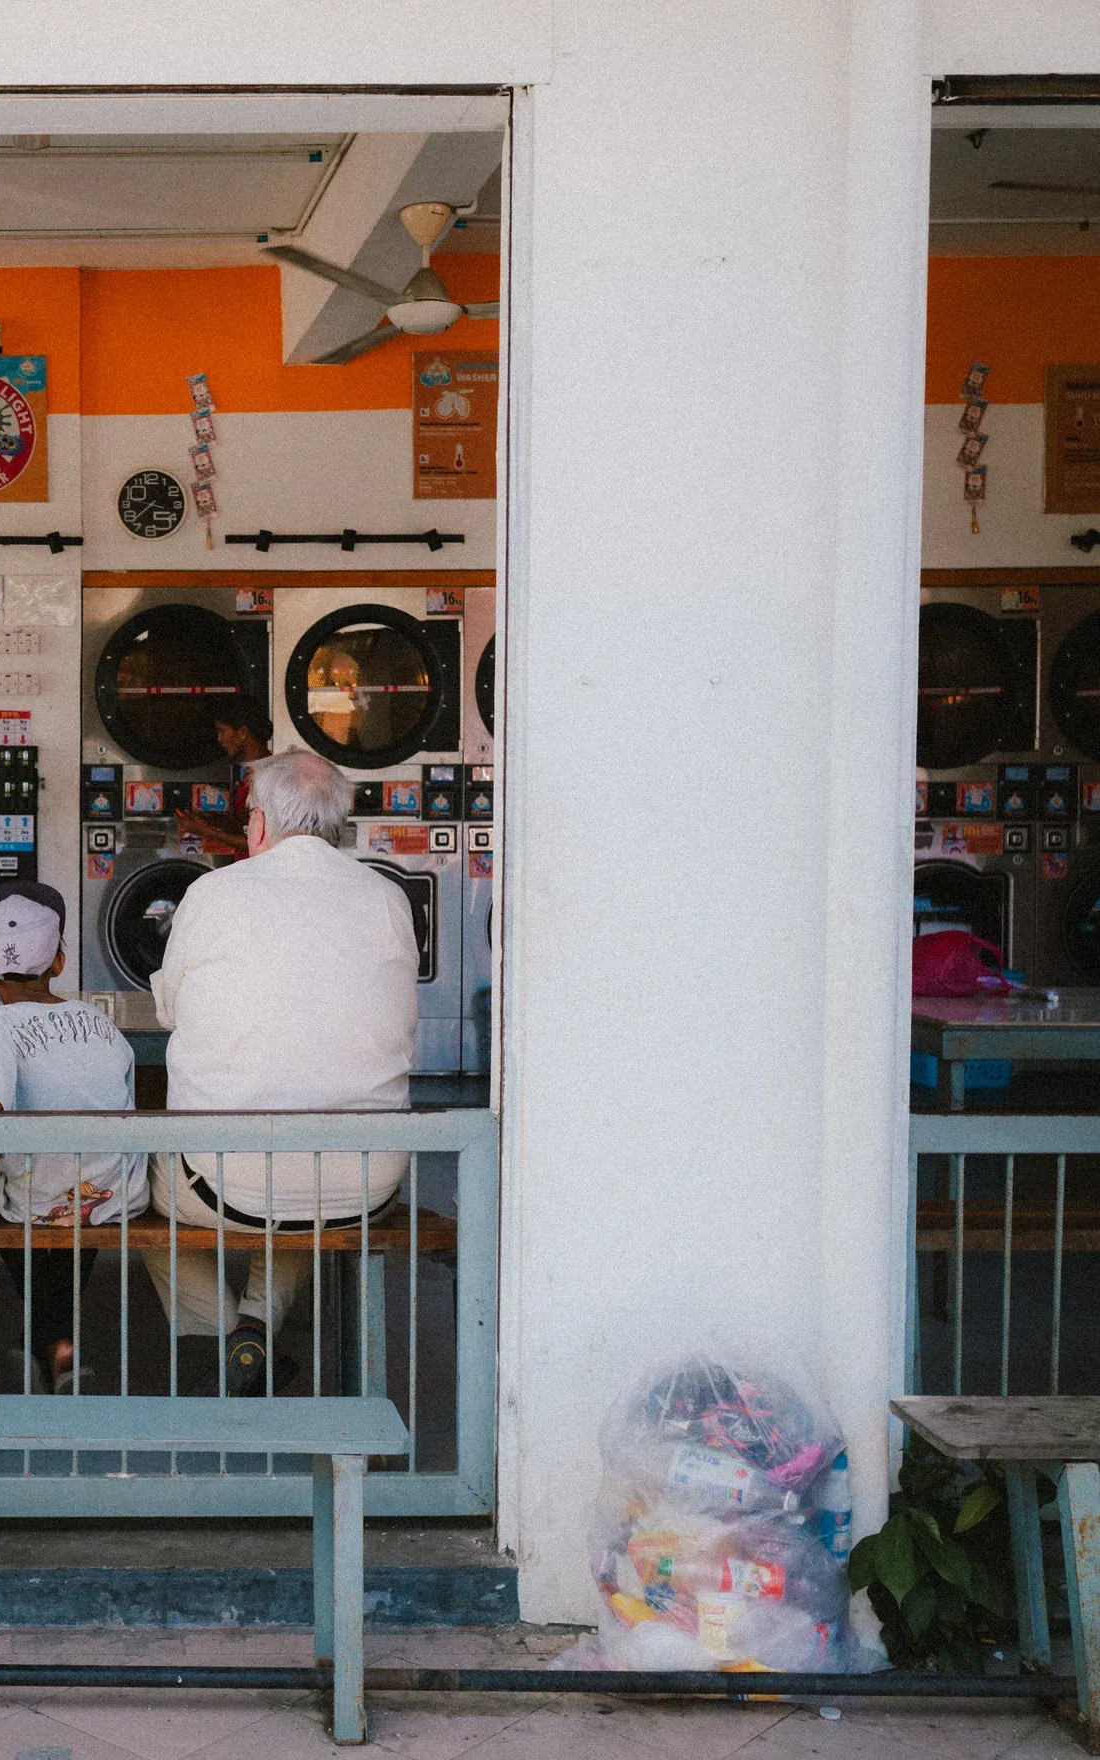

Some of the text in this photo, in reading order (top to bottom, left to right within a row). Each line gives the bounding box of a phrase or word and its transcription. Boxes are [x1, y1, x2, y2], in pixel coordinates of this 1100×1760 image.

[456, 373, 498, 382] WASHER
[0, 385, 33, 435] LIGHT
[142, 472, 160, 485] 12
[161, 477, 167, 486] 1
[124, 485, 147, 502] 10
[168, 486, 180, 497] 2
[121, 500, 131, 509] 9
[173, 501, 183, 509] 3
[123, 510, 136, 522] 8
[153, 511, 173, 530] 5
[132, 523, 142, 532] 7
[145, 524, 157, 537] 6
